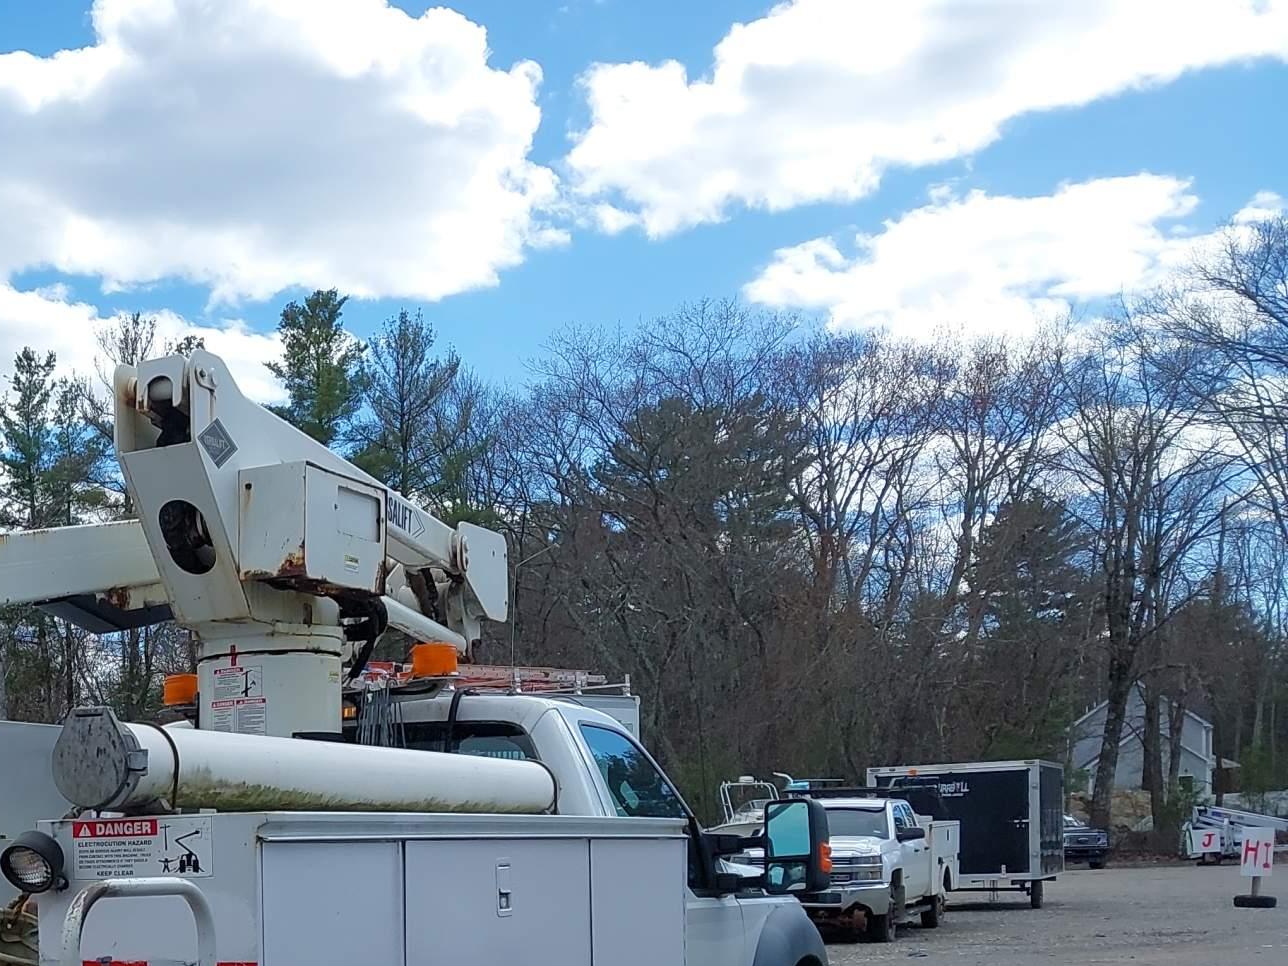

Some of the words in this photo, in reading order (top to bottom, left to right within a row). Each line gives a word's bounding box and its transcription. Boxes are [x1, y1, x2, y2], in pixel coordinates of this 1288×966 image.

[95, 821, 152, 836] DANGER
[127, 839, 152, 847] HAZARD
[1201, 833, 1216, 848] J
